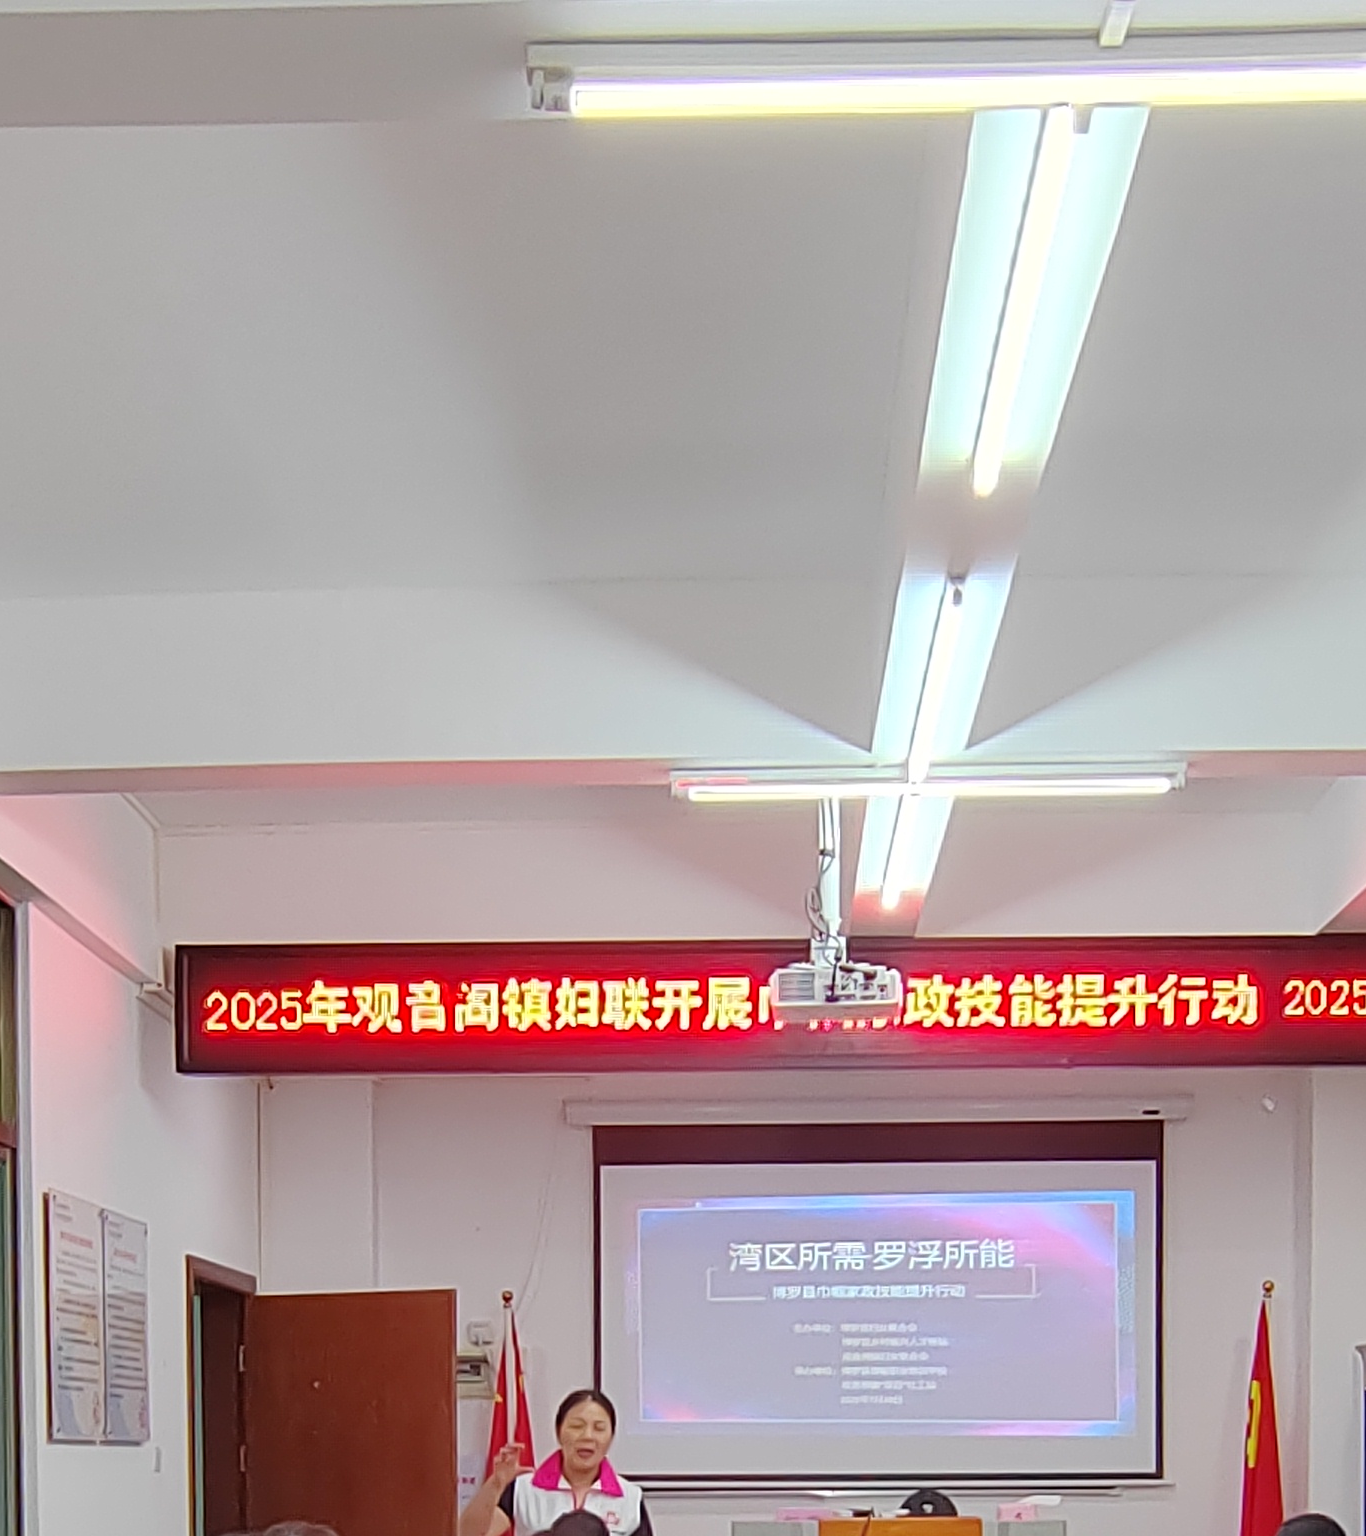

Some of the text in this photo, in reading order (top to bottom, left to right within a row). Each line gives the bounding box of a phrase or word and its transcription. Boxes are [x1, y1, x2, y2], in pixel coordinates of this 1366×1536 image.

[205, 974, 1259, 1032] 2025年观音阁镇妇联开展政技能提升行动
